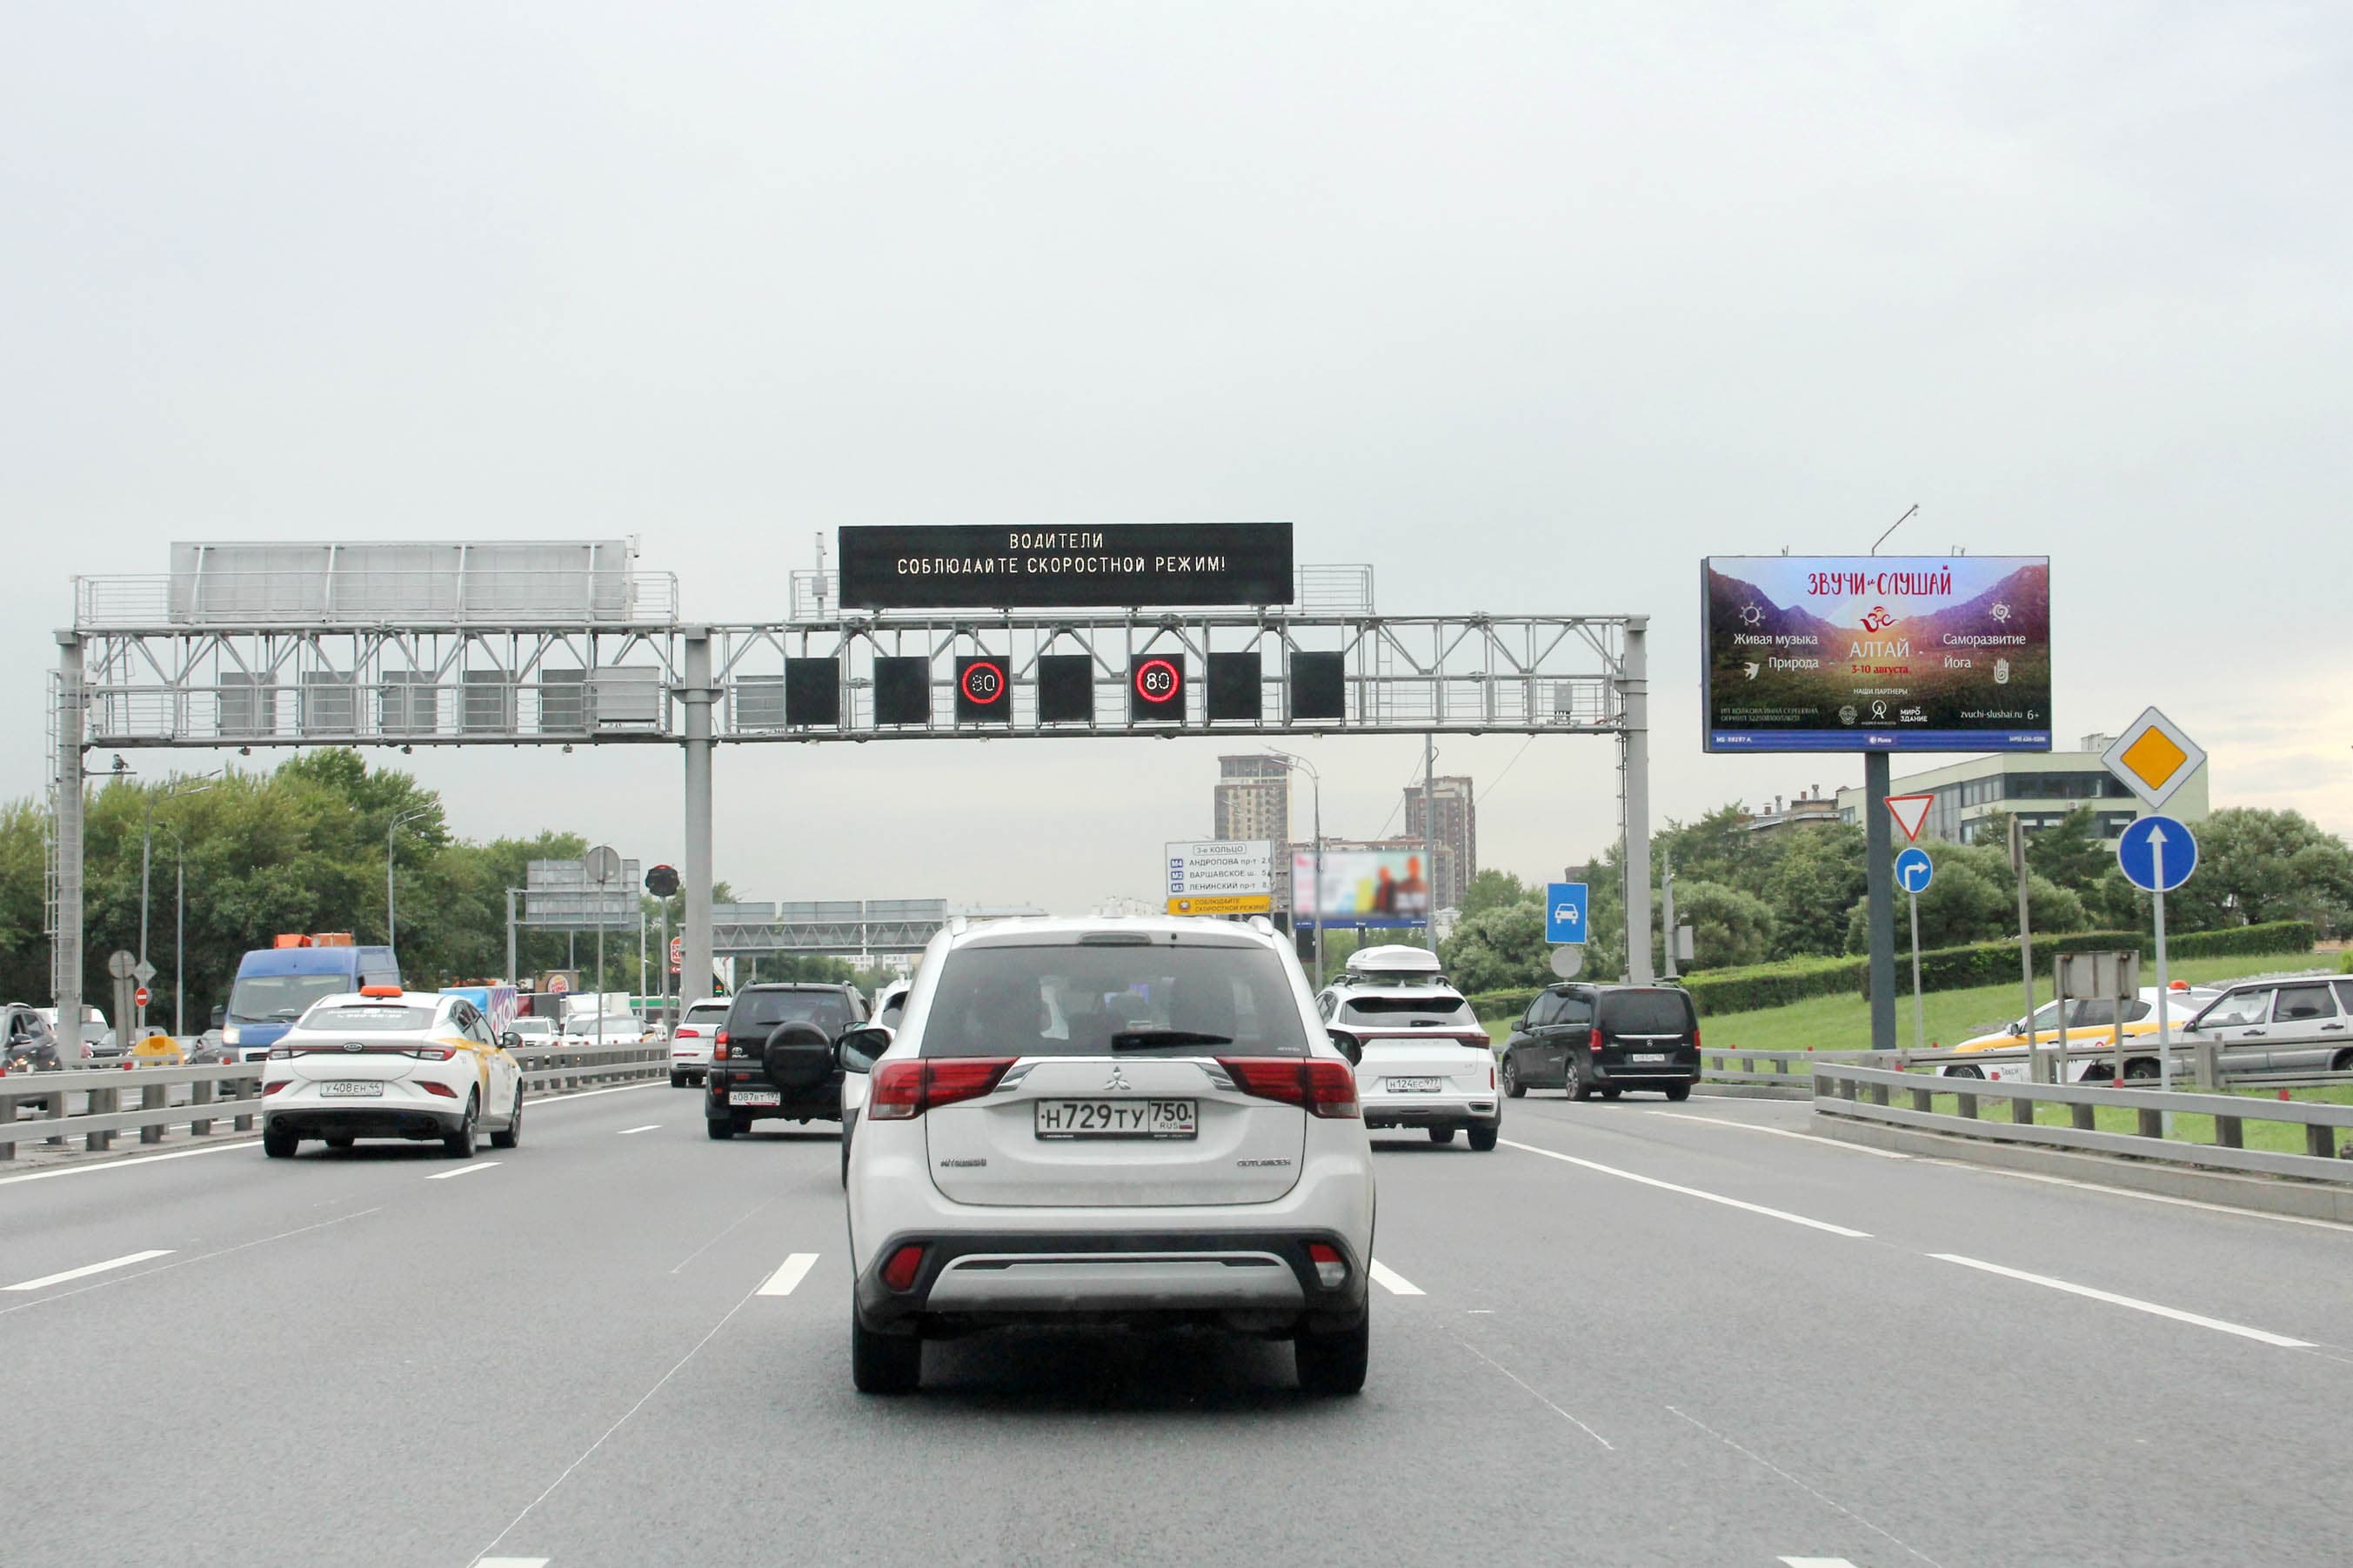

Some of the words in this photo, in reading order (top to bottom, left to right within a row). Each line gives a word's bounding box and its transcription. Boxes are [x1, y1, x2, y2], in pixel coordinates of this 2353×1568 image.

[1009, 532, 1104, 550] ВОДИТЕЛИ
[897, 557, 1019, 575] СОБЛЮДАЙТЕ
[1026, 557, 1146, 574] СКОРОСТНОЙ
[1155, 556, 1227, 572] РЕЖИМ!
[1808, 572, 1866, 595] ЗВУЧИ
[1876, 564, 1952, 595] СЛУШАЙ
[1734, 633, 1773, 644] Живая
[1775, 635, 1818, 648] музыка
[1849, 637, 1909, 657] АЛТАЙ
[1942, 633, 2027, 648] Саморазвитие
[1768, 657, 1819, 671] Природа
[1944, 654, 1972, 669] Йога
[1851, 664, 1871, 674] 3-10
[1873, 665, 1909, 675] августа
[972, 674, 995, 692] 80
[1146, 672, 1170, 691] 80
[1960, 710, 2022, 719] zvuchi-slushai.ru
[2028, 709, 2040, 720] 6+
[1189, 857, 1239, 866] АНДРОПОВА
[1189, 870, 1246, 878] ВАРШАВСКОЕ
[1189, 882, 1238, 891] ЛЕНИНСКИЙ
[325, 1083, 366, 1093] У408ЕН
[1390, 1079, 1423, 1088] Н124ЕС
[1046, 1104, 1145, 1129] Н729ТУ
[1150, 1103, 1189, 1122] 750
